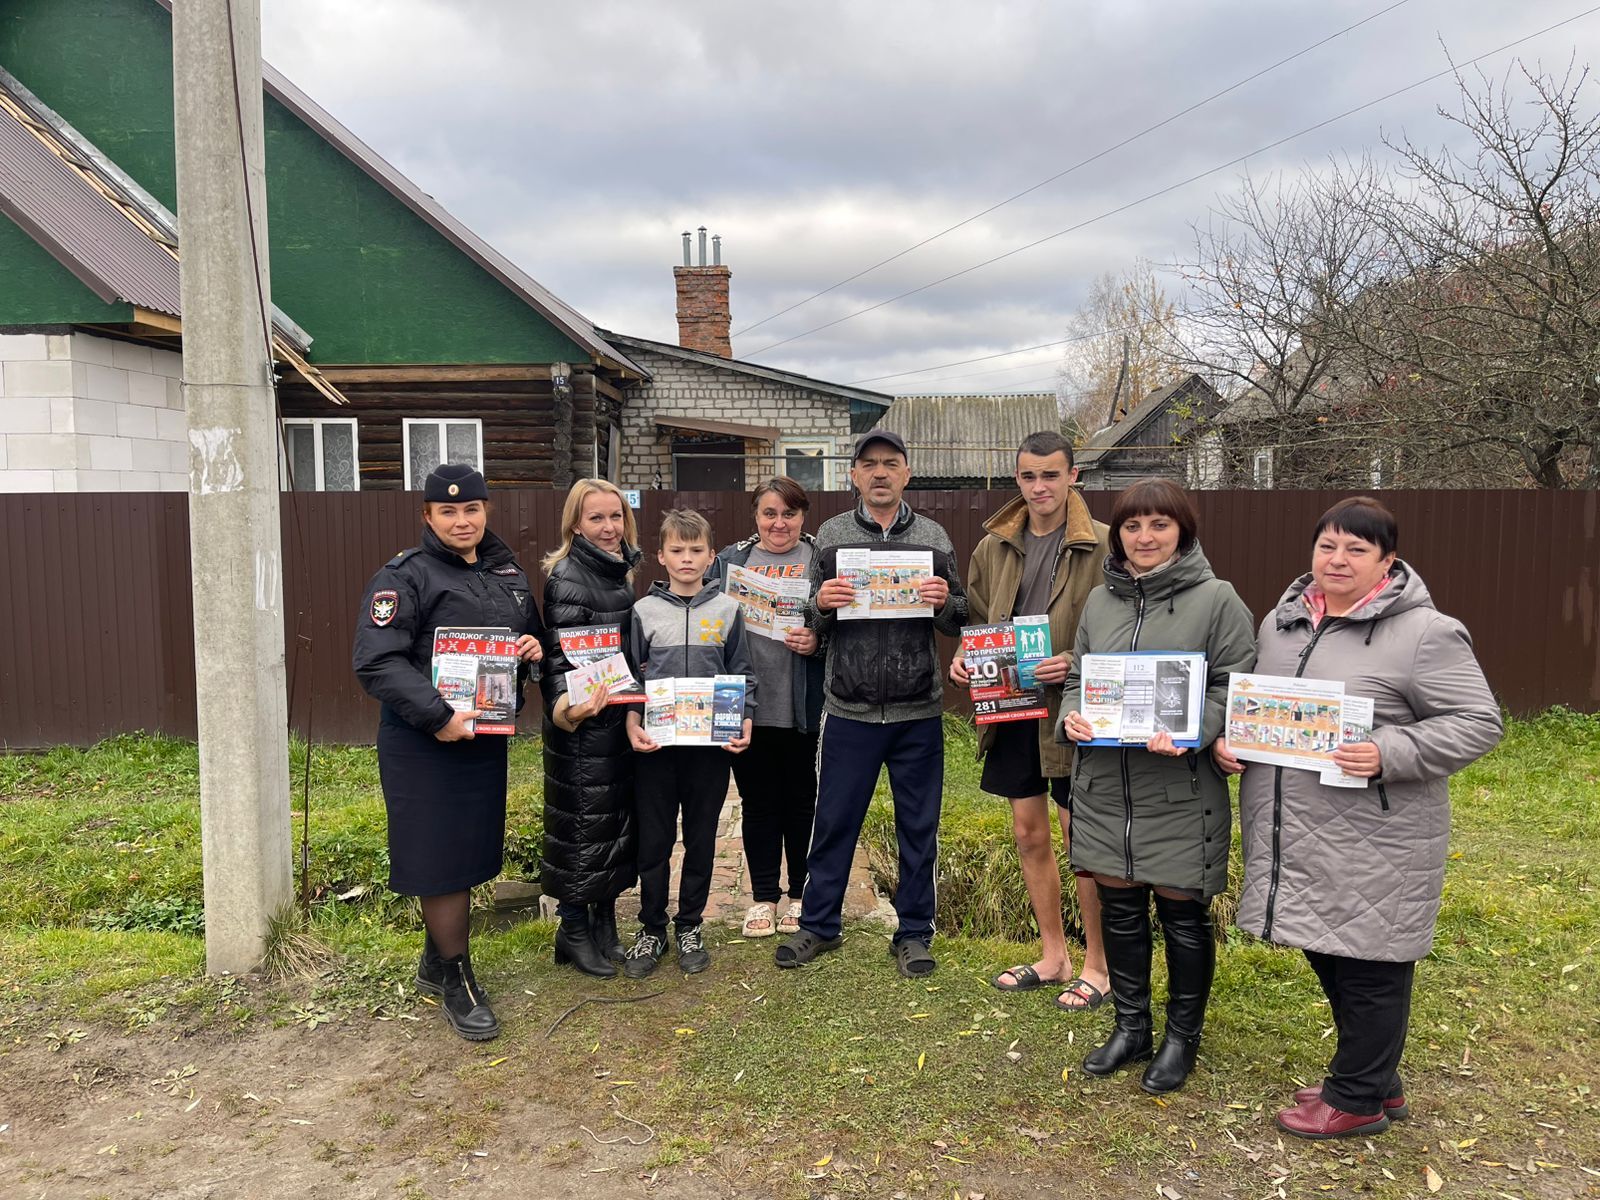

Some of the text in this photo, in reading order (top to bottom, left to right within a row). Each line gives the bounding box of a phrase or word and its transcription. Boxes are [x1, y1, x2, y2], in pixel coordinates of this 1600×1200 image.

[448, 632, 484, 641] ПОДЖОГ
[489, 634, 505, 642] ЭТО
[560, 629, 590, 639] ПОДЖОГ
[595, 627, 608, 635] ЭТО
[609, 626, 618, 634] НЕ
[963, 627, 998, 637] ПОДЖОГ
[562, 634, 618, 650] ХАЙП
[964, 632, 1014, 650] ХАЙ
[447, 640, 516, 656] ХАЙП
[966, 646, 1016, 657] ЭТО ПРЕСТУПЛ
[970, 661, 998, 679] 10
[975, 701, 996, 711] 281
